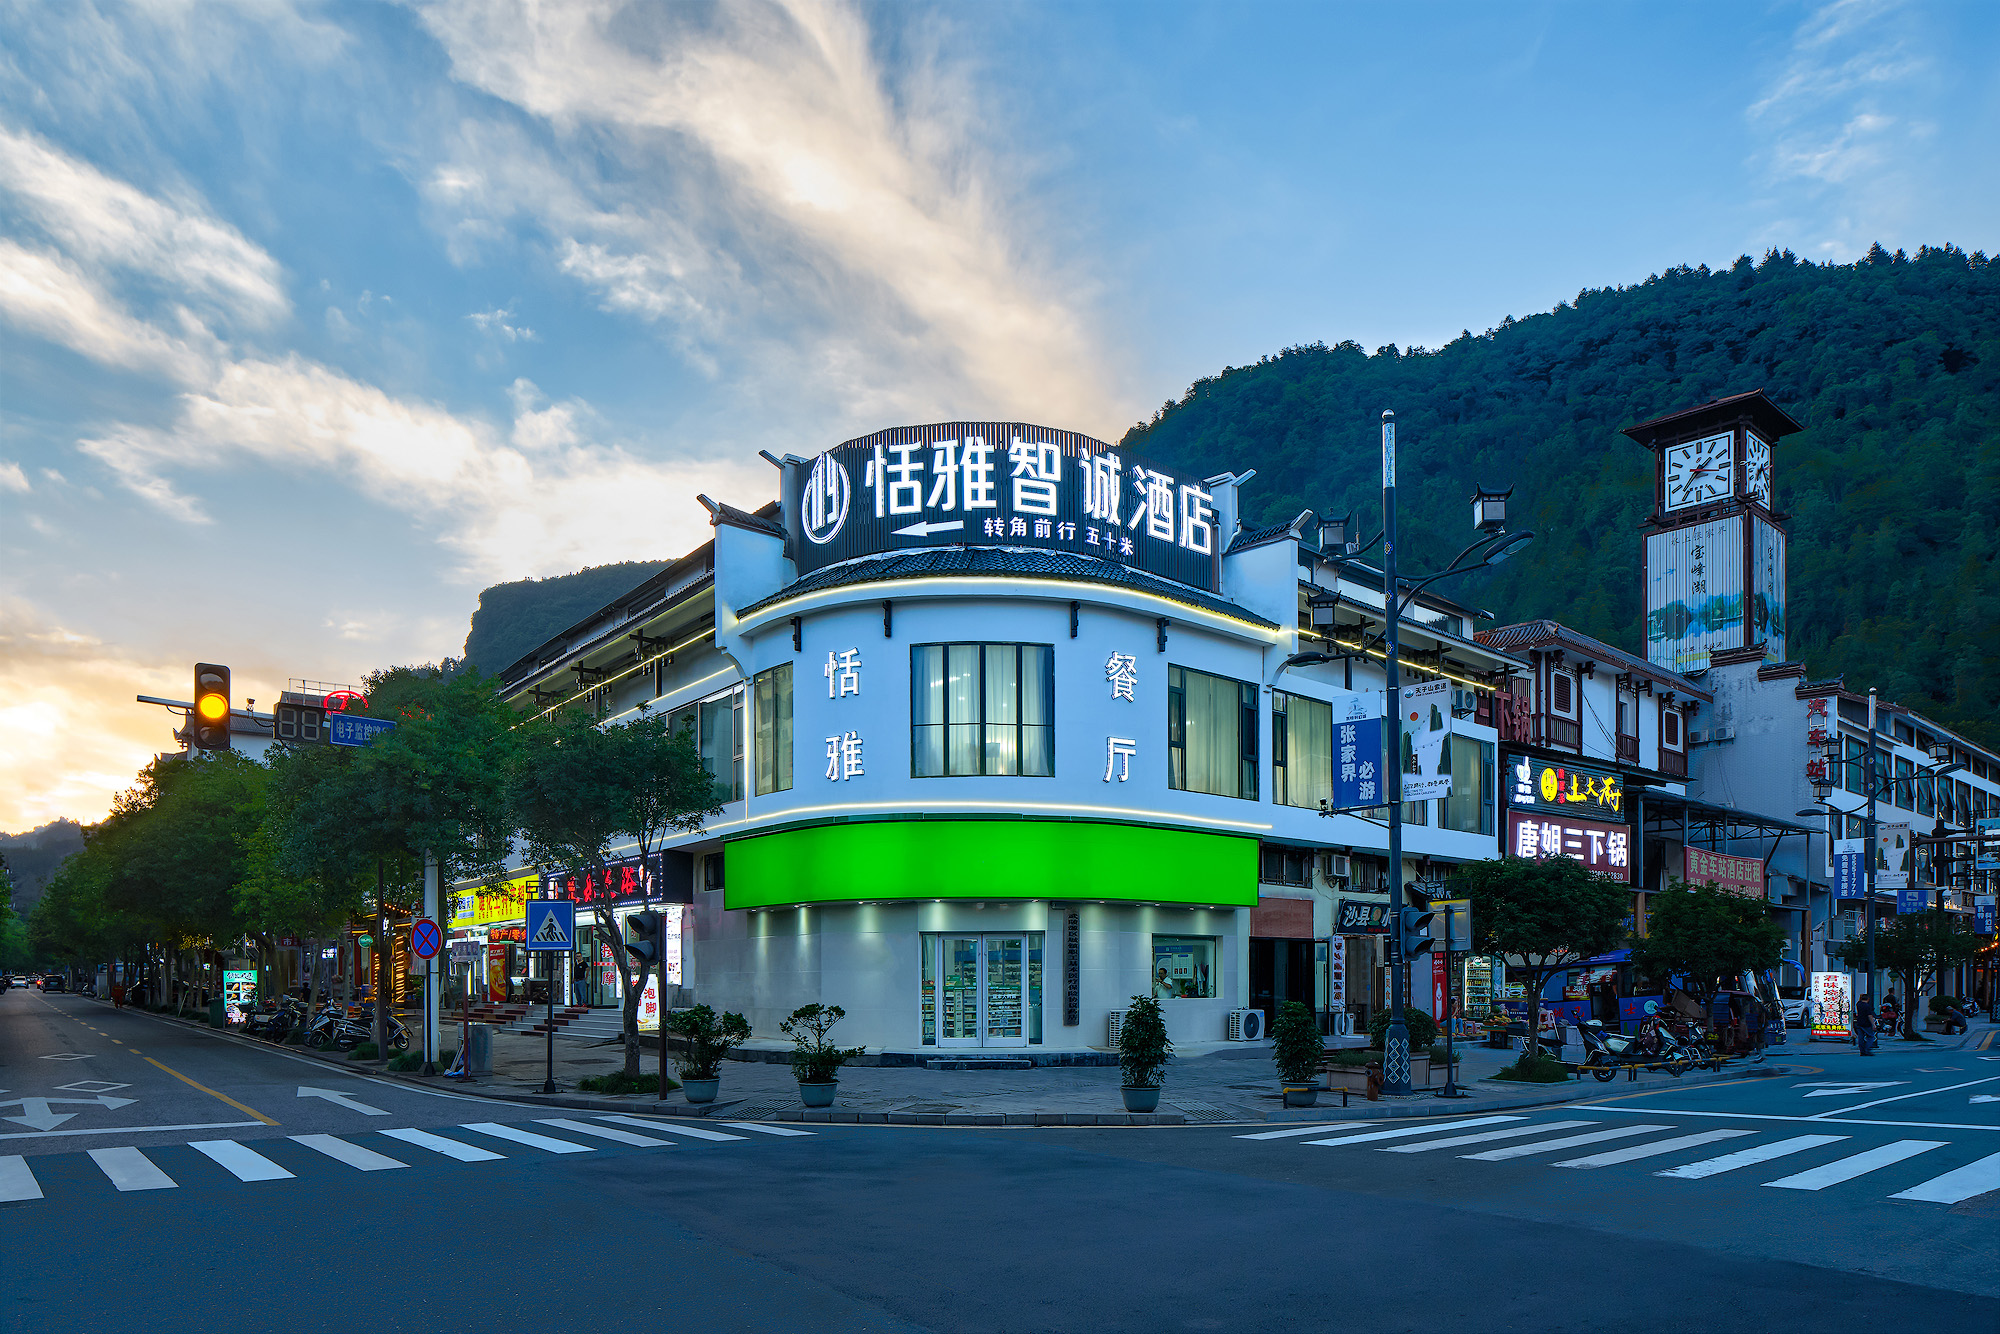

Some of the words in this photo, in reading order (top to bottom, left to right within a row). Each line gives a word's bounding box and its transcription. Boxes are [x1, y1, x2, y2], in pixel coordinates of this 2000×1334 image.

[865, 436, 1214, 555] 恬雅智诚酒店
[1691, 545, 1706, 594] 宝峰湖
[824, 647, 865, 782] 恬雅
[1103, 651, 1138, 783] 餐厅
[1806, 698, 1827, 781] 汽车站
[1340, 724, 1357, 783] 张家界
[1358, 760, 1376, 801] 必游
[1514, 820, 1628, 868] 唐姐三下锅
[1689, 850, 1761, 883] 黄金车站酒店出租
[644, 987, 658, 1014] 泡脚
